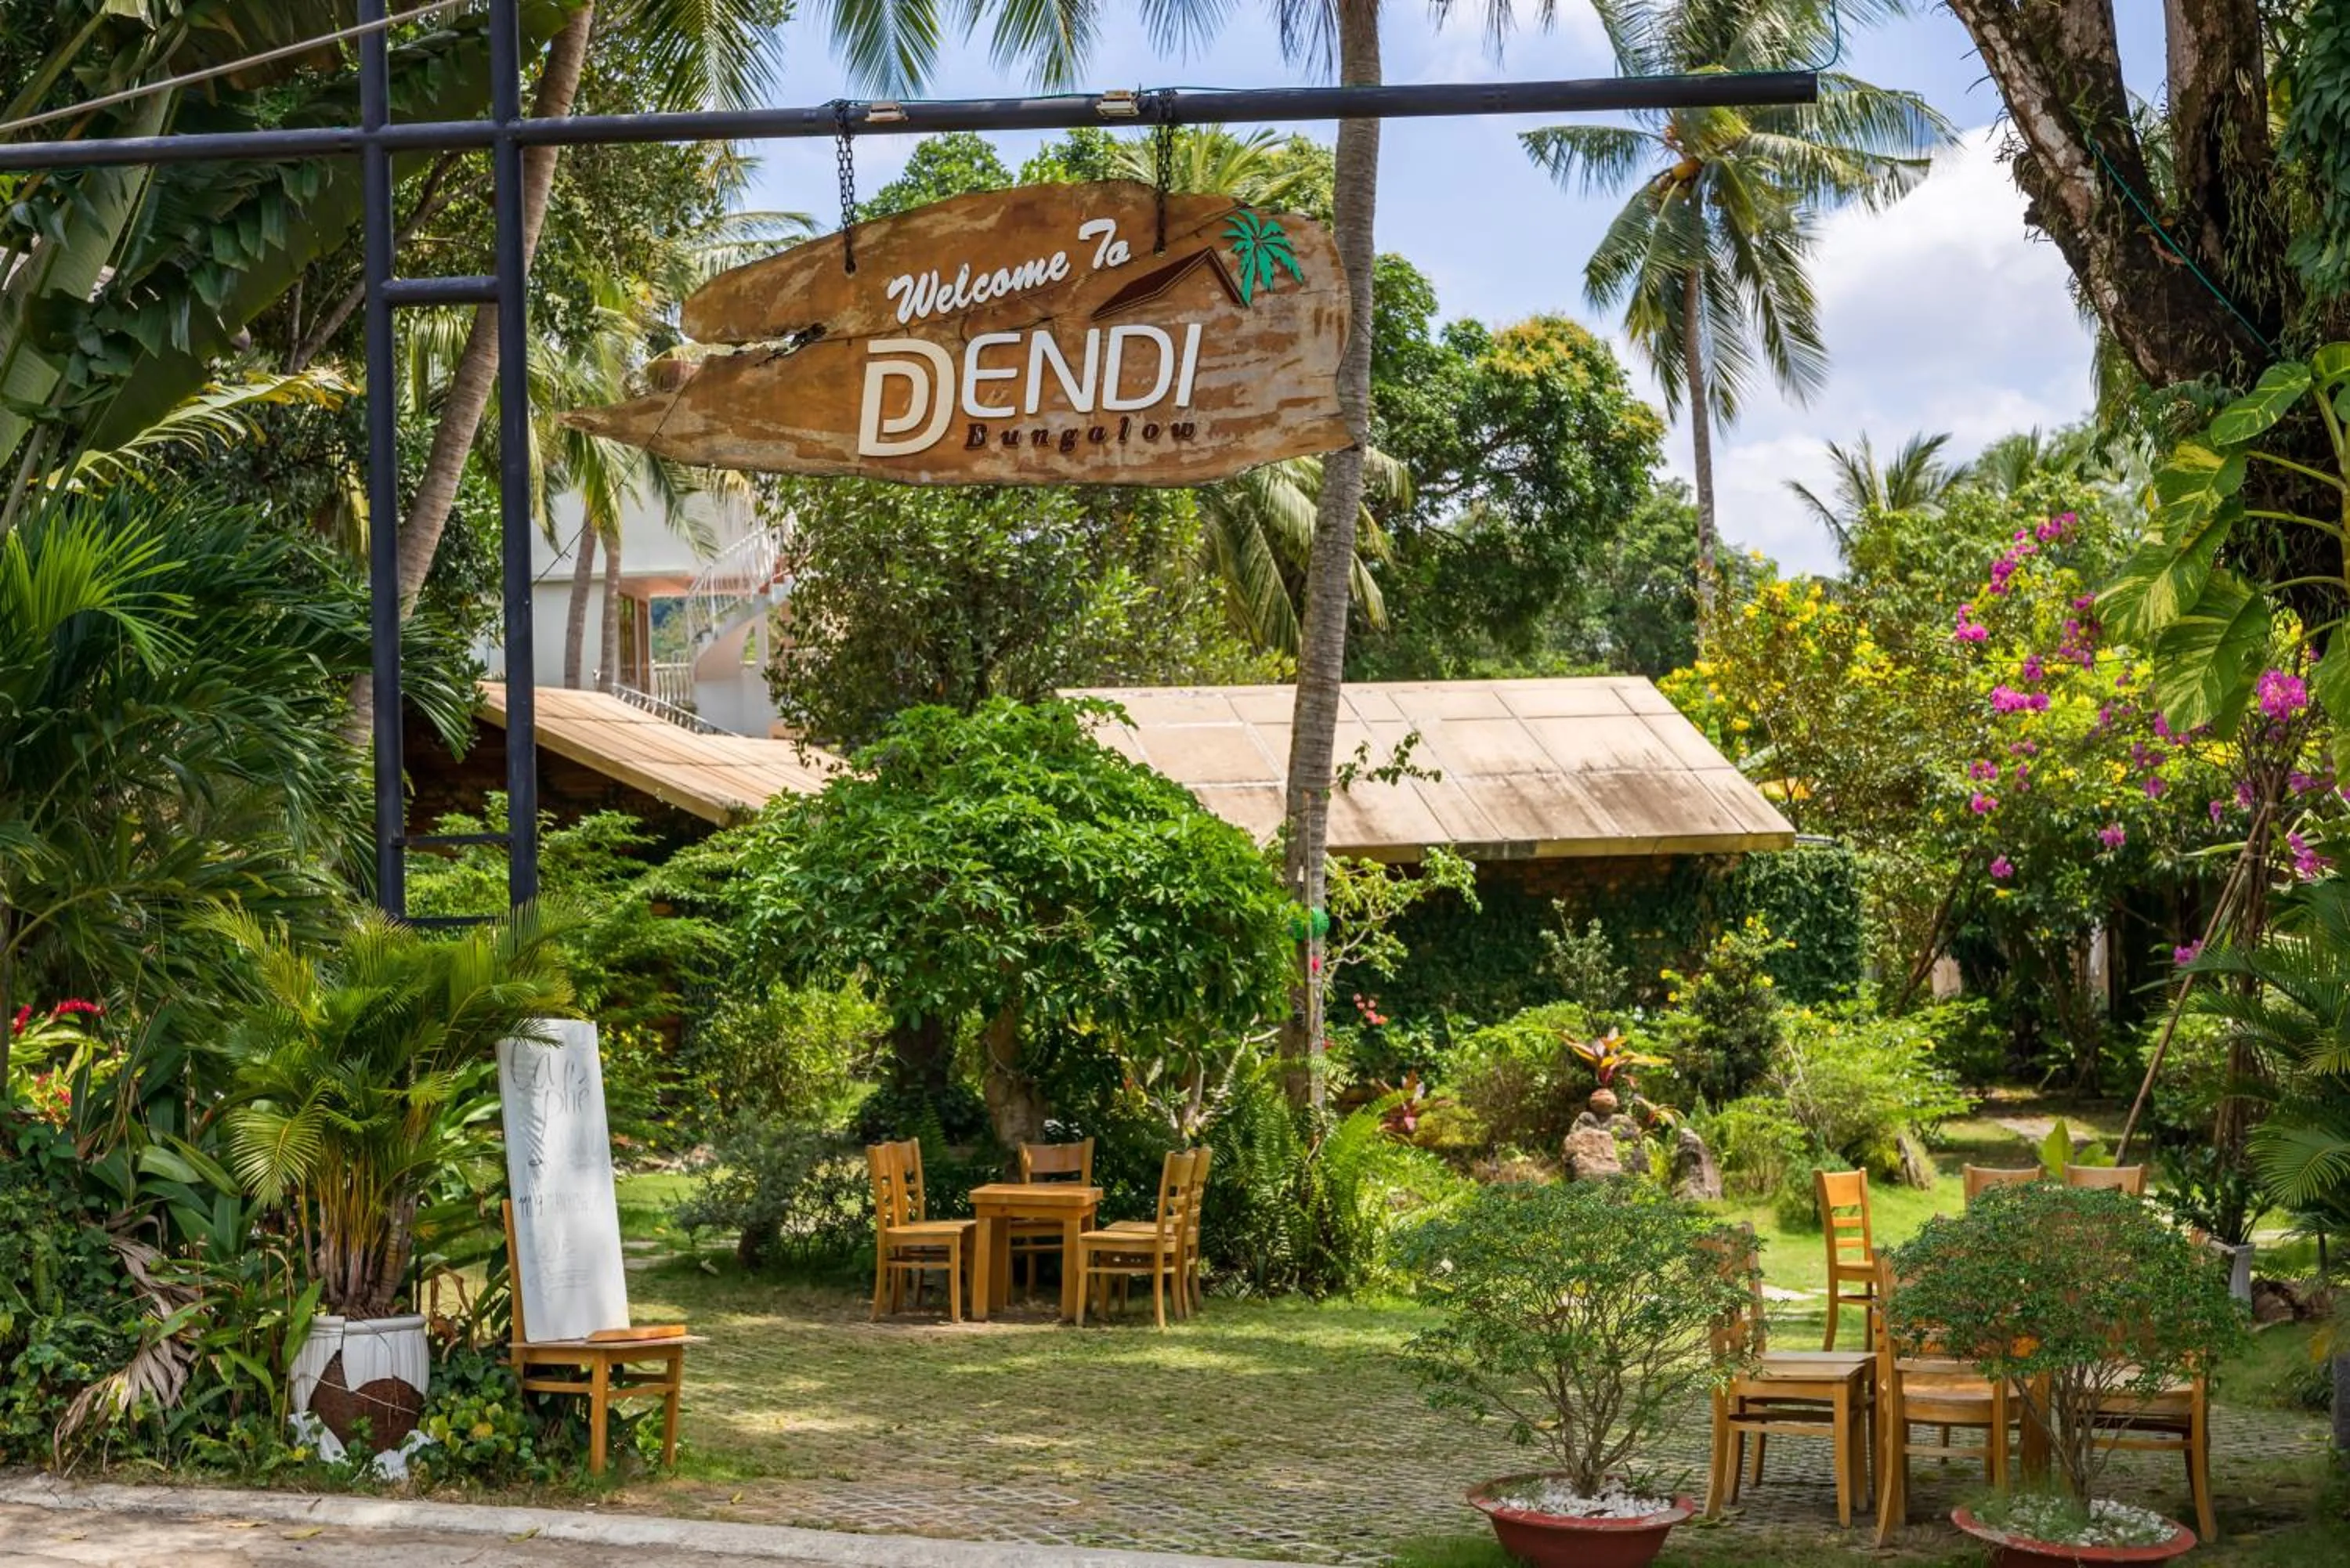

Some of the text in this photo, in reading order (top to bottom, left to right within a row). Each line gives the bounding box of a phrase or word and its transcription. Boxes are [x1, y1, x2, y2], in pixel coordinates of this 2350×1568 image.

[887, 219, 1131, 324] Welcome To
[858, 323, 1203, 457] DENDI
[966, 416, 1196, 452] Bungalow
